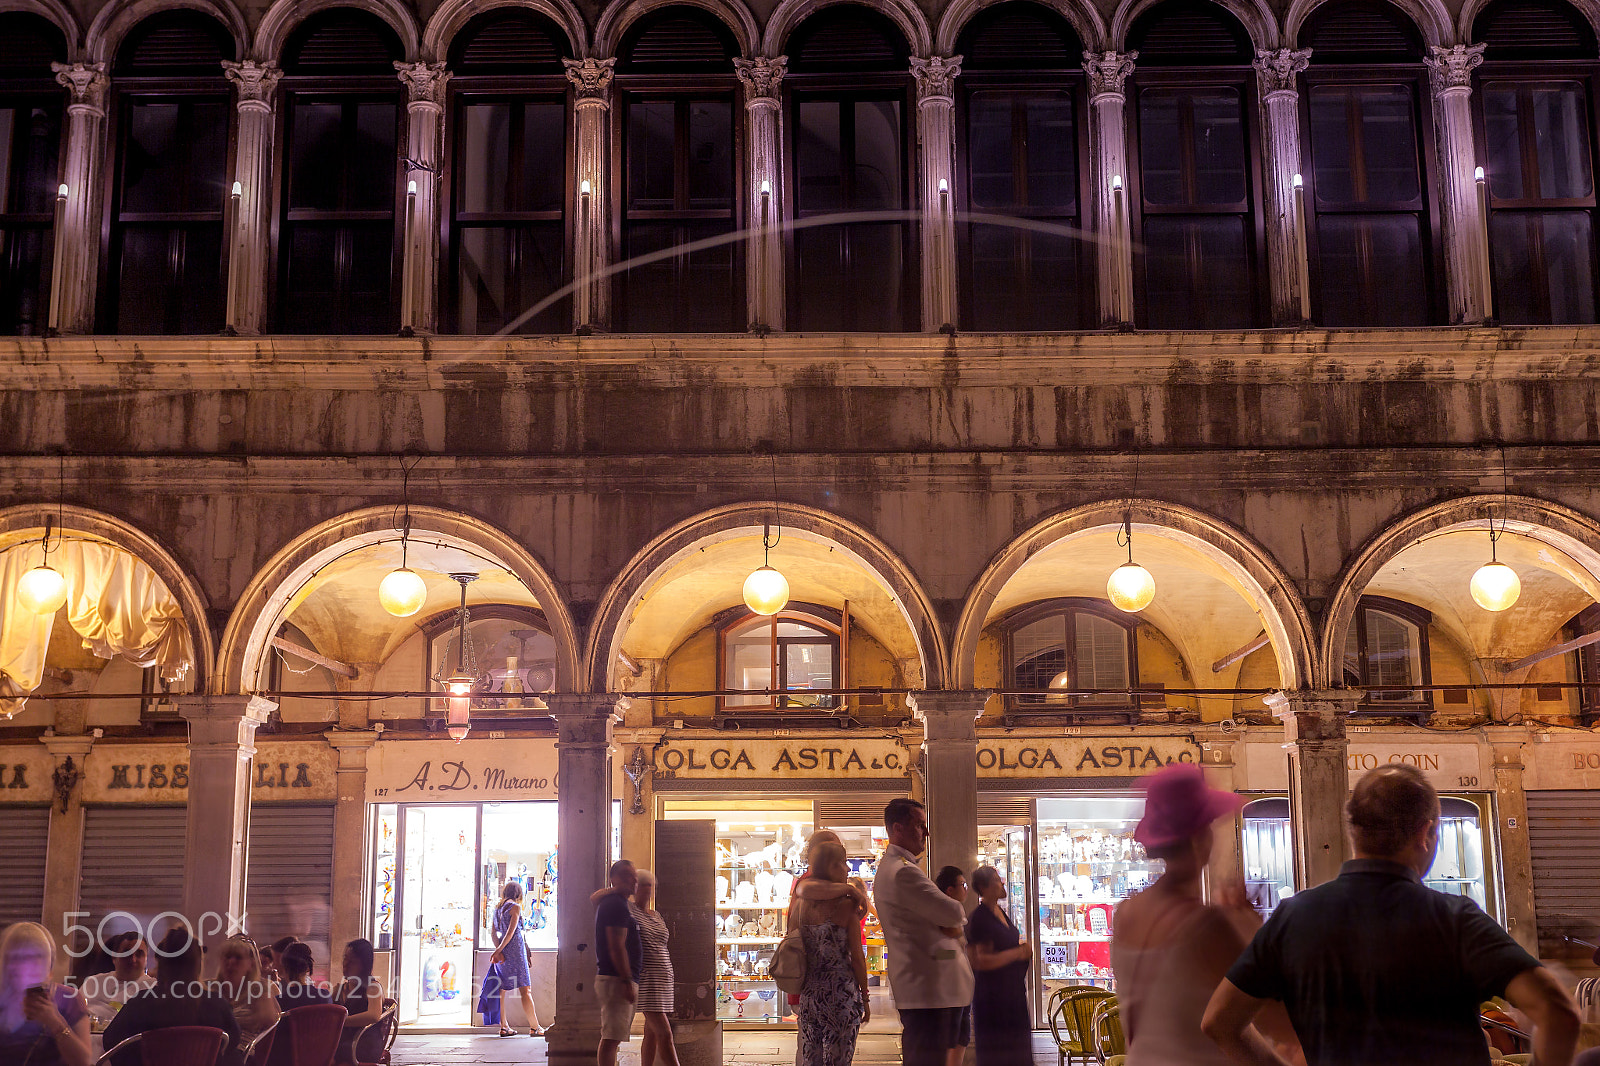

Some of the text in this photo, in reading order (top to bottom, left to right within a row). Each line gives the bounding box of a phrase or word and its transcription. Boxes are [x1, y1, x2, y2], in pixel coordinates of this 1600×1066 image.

[663, 749, 755, 770] OLGA
[772, 748, 866, 770] ASTA
[884, 753, 903, 770] C.
[976, 747, 1062, 770] OLGA
[1076, 746, 1164, 771] ASTA
[1388, 753, 1439, 771] COIN
[483, 767, 548, 790] Murano
[1458, 776, 1478, 787] 130
[374, 788, 389, 797] 127
[1045, 947, 1066, 956] 50 %
